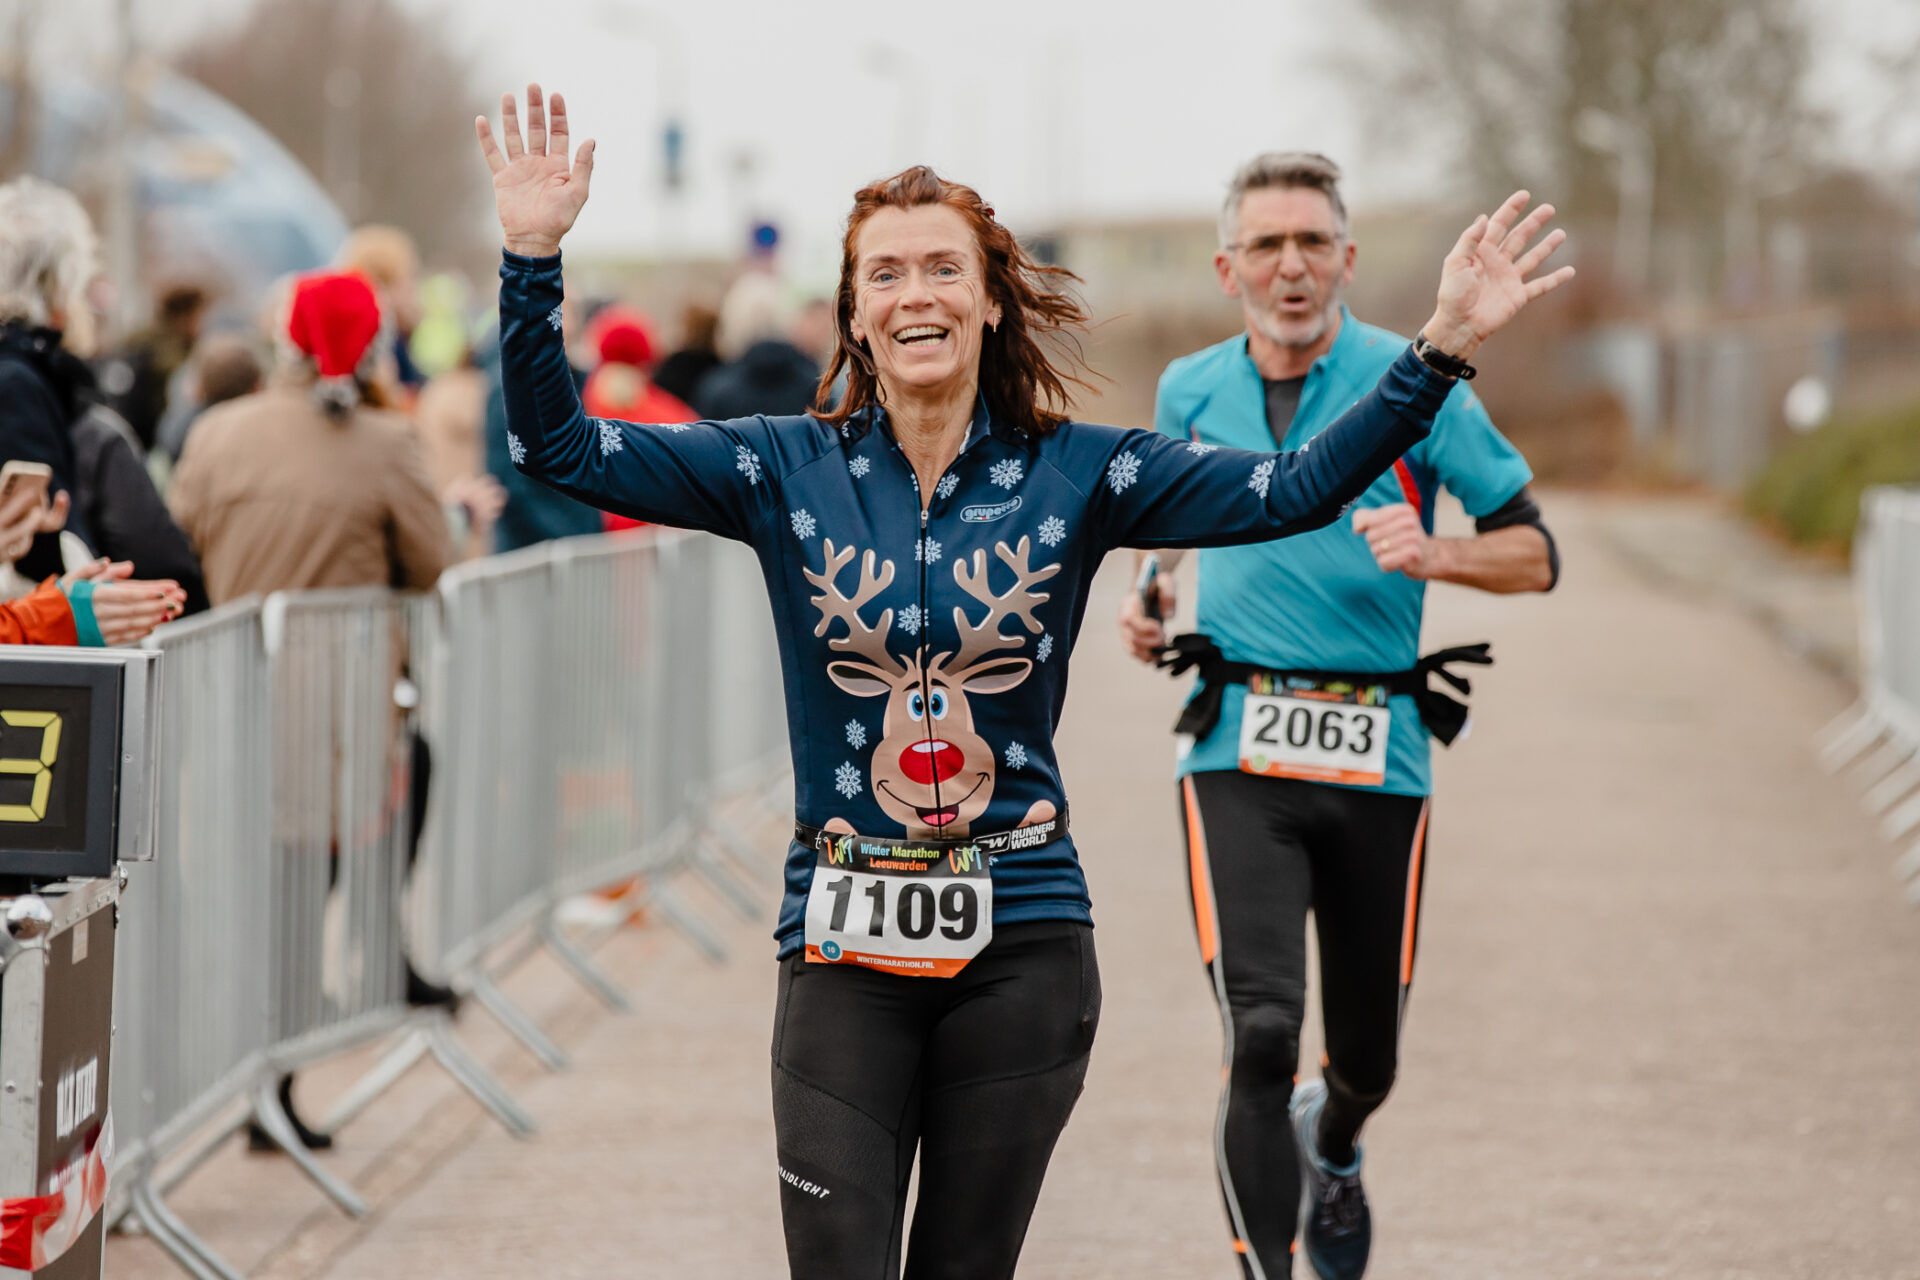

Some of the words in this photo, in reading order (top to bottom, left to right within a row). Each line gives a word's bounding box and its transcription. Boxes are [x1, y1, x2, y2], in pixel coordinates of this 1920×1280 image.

[1254, 704, 1373, 754] 2063
[1011, 820, 1056, 840] RUNNERS
[1010, 833, 1047, 850] WORLD
[860, 843, 891, 857] Winter
[891, 847, 940, 860] Marathon
[869, 857, 928, 872] Leeuwarden
[826, 875, 978, 941] 1109
[856, 955, 935, 969] WINTERMARATHON.FRL
